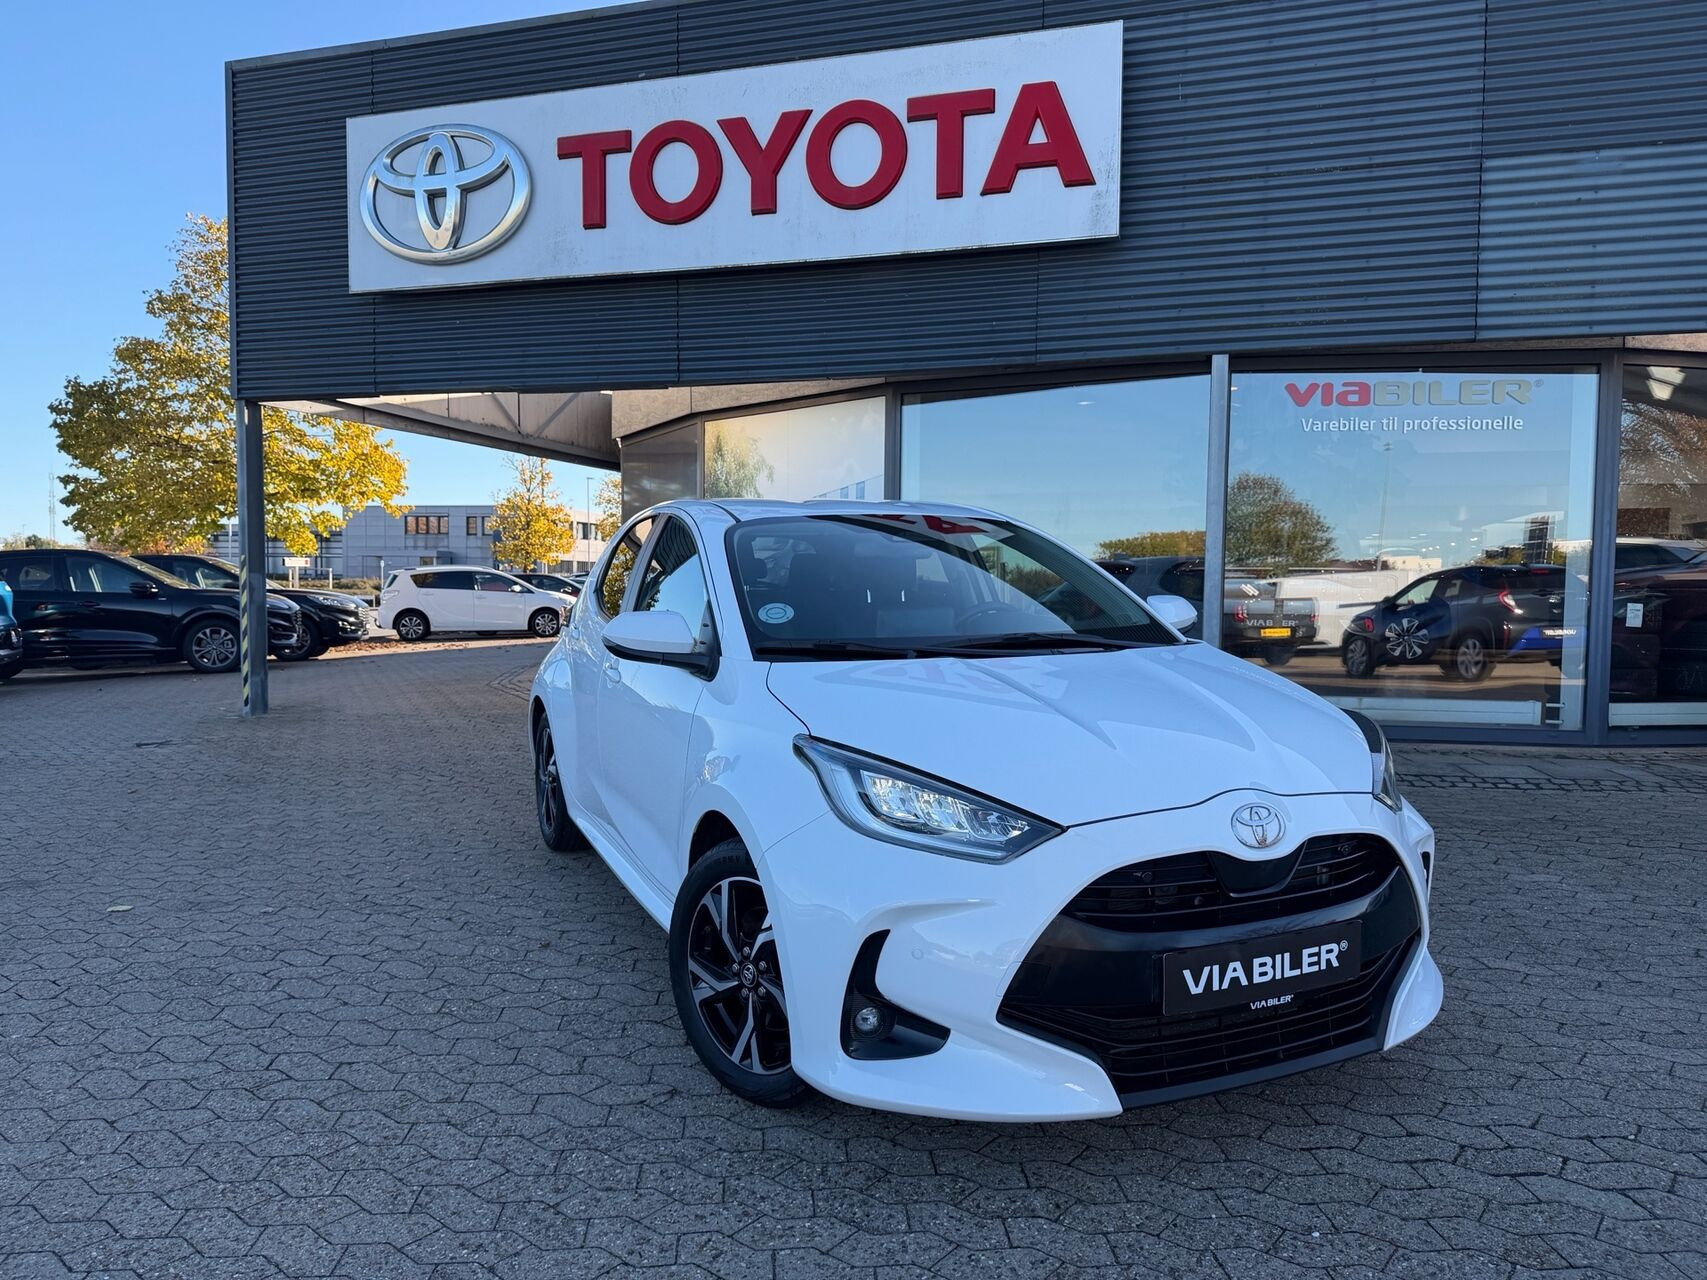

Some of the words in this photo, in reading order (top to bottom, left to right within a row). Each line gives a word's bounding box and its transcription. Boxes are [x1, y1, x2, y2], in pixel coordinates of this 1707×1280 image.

[557, 81, 1096, 230] TOYOTA
[1301, 417, 1376, 432] Varebiler
[1381, 417, 1398, 431] til
[1402, 416, 1524, 434] professionelle
